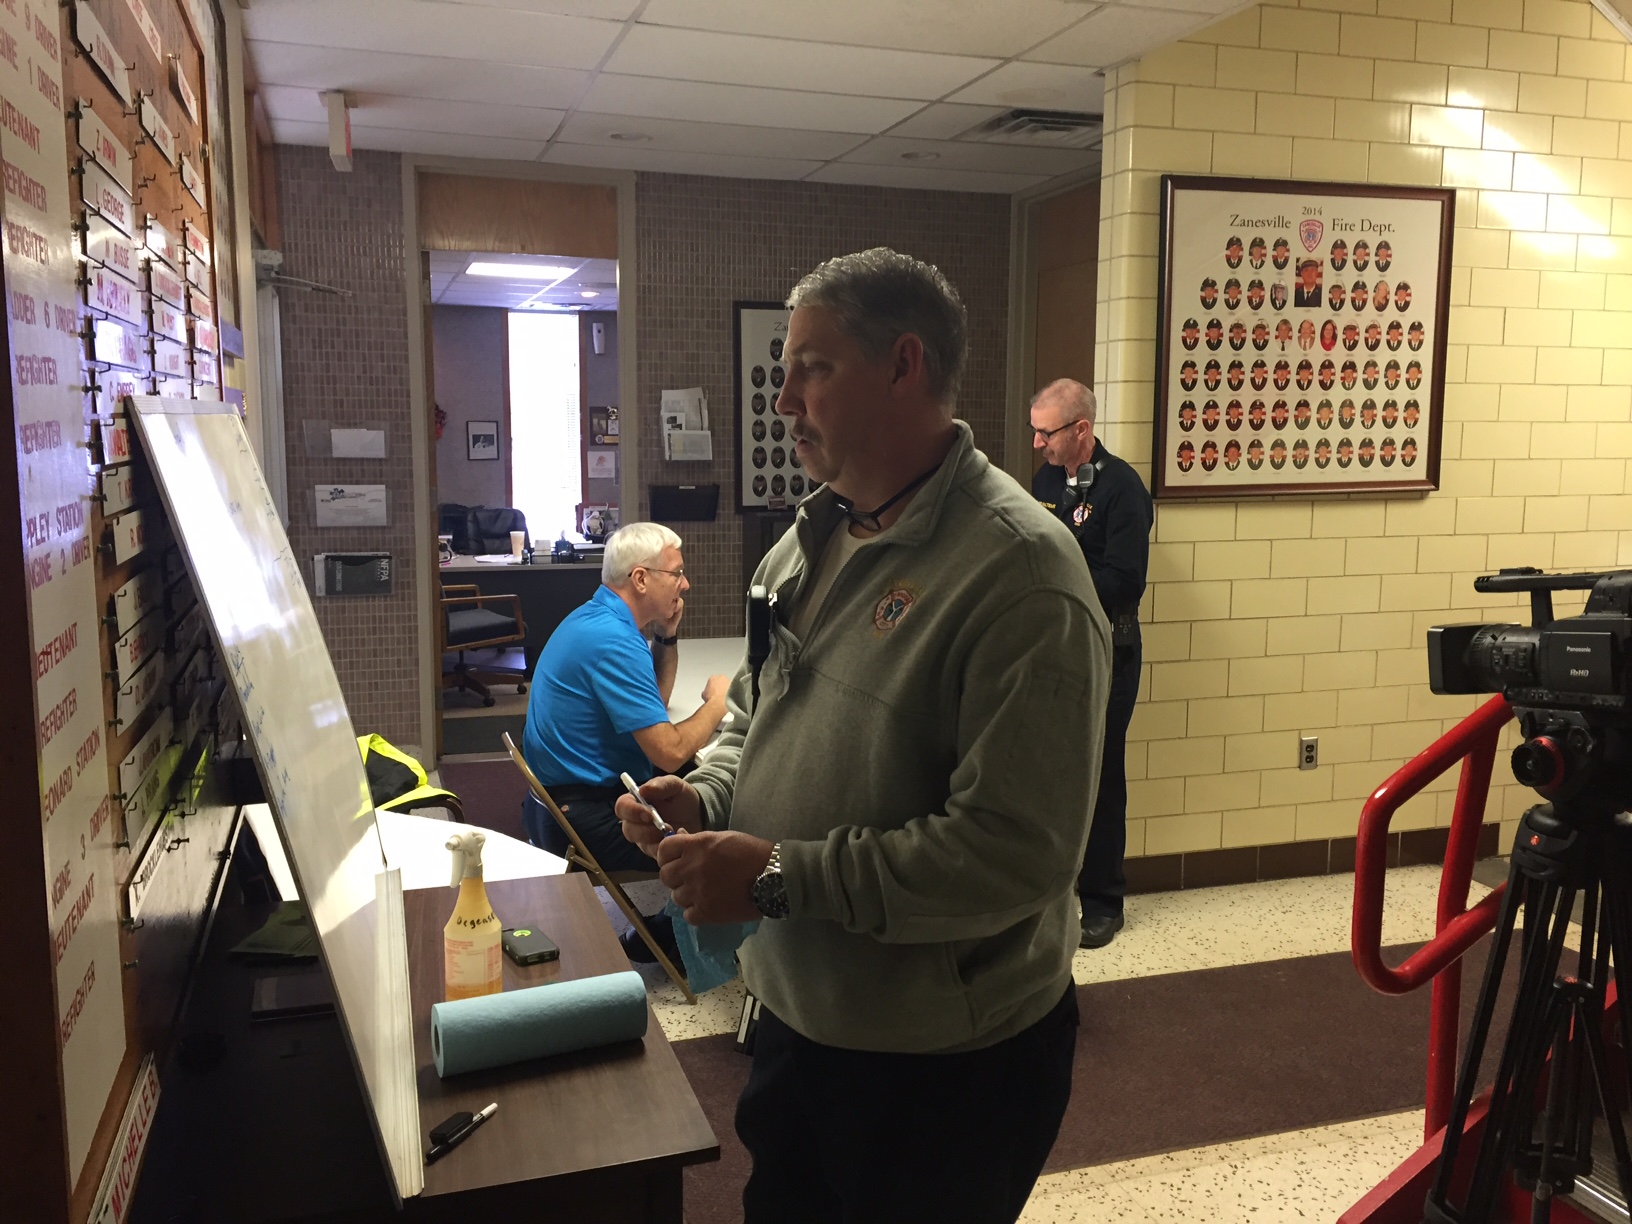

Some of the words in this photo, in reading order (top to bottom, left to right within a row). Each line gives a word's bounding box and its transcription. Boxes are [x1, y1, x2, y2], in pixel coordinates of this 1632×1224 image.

[0, 94, 40, 155] UTENANT
[102, 188, 125, 225] GEORGE
[1301, 205, 1323, 217] 2014
[1229, 213, 1292, 229] Zanesville
[1331, 217, 1356, 232] Fire
[1359, 218, 1396, 236] Dept.
[43, 301, 51, 330] 6
[55, 501, 84, 537] STATION
[60, 548, 67, 575] 2
[380, 558, 389, 581] NFPA
[1566, 645, 1591, 653] Panasonic
[76, 726, 100, 777] STATION
[111, 1085, 151, 1224] MICHELLE
